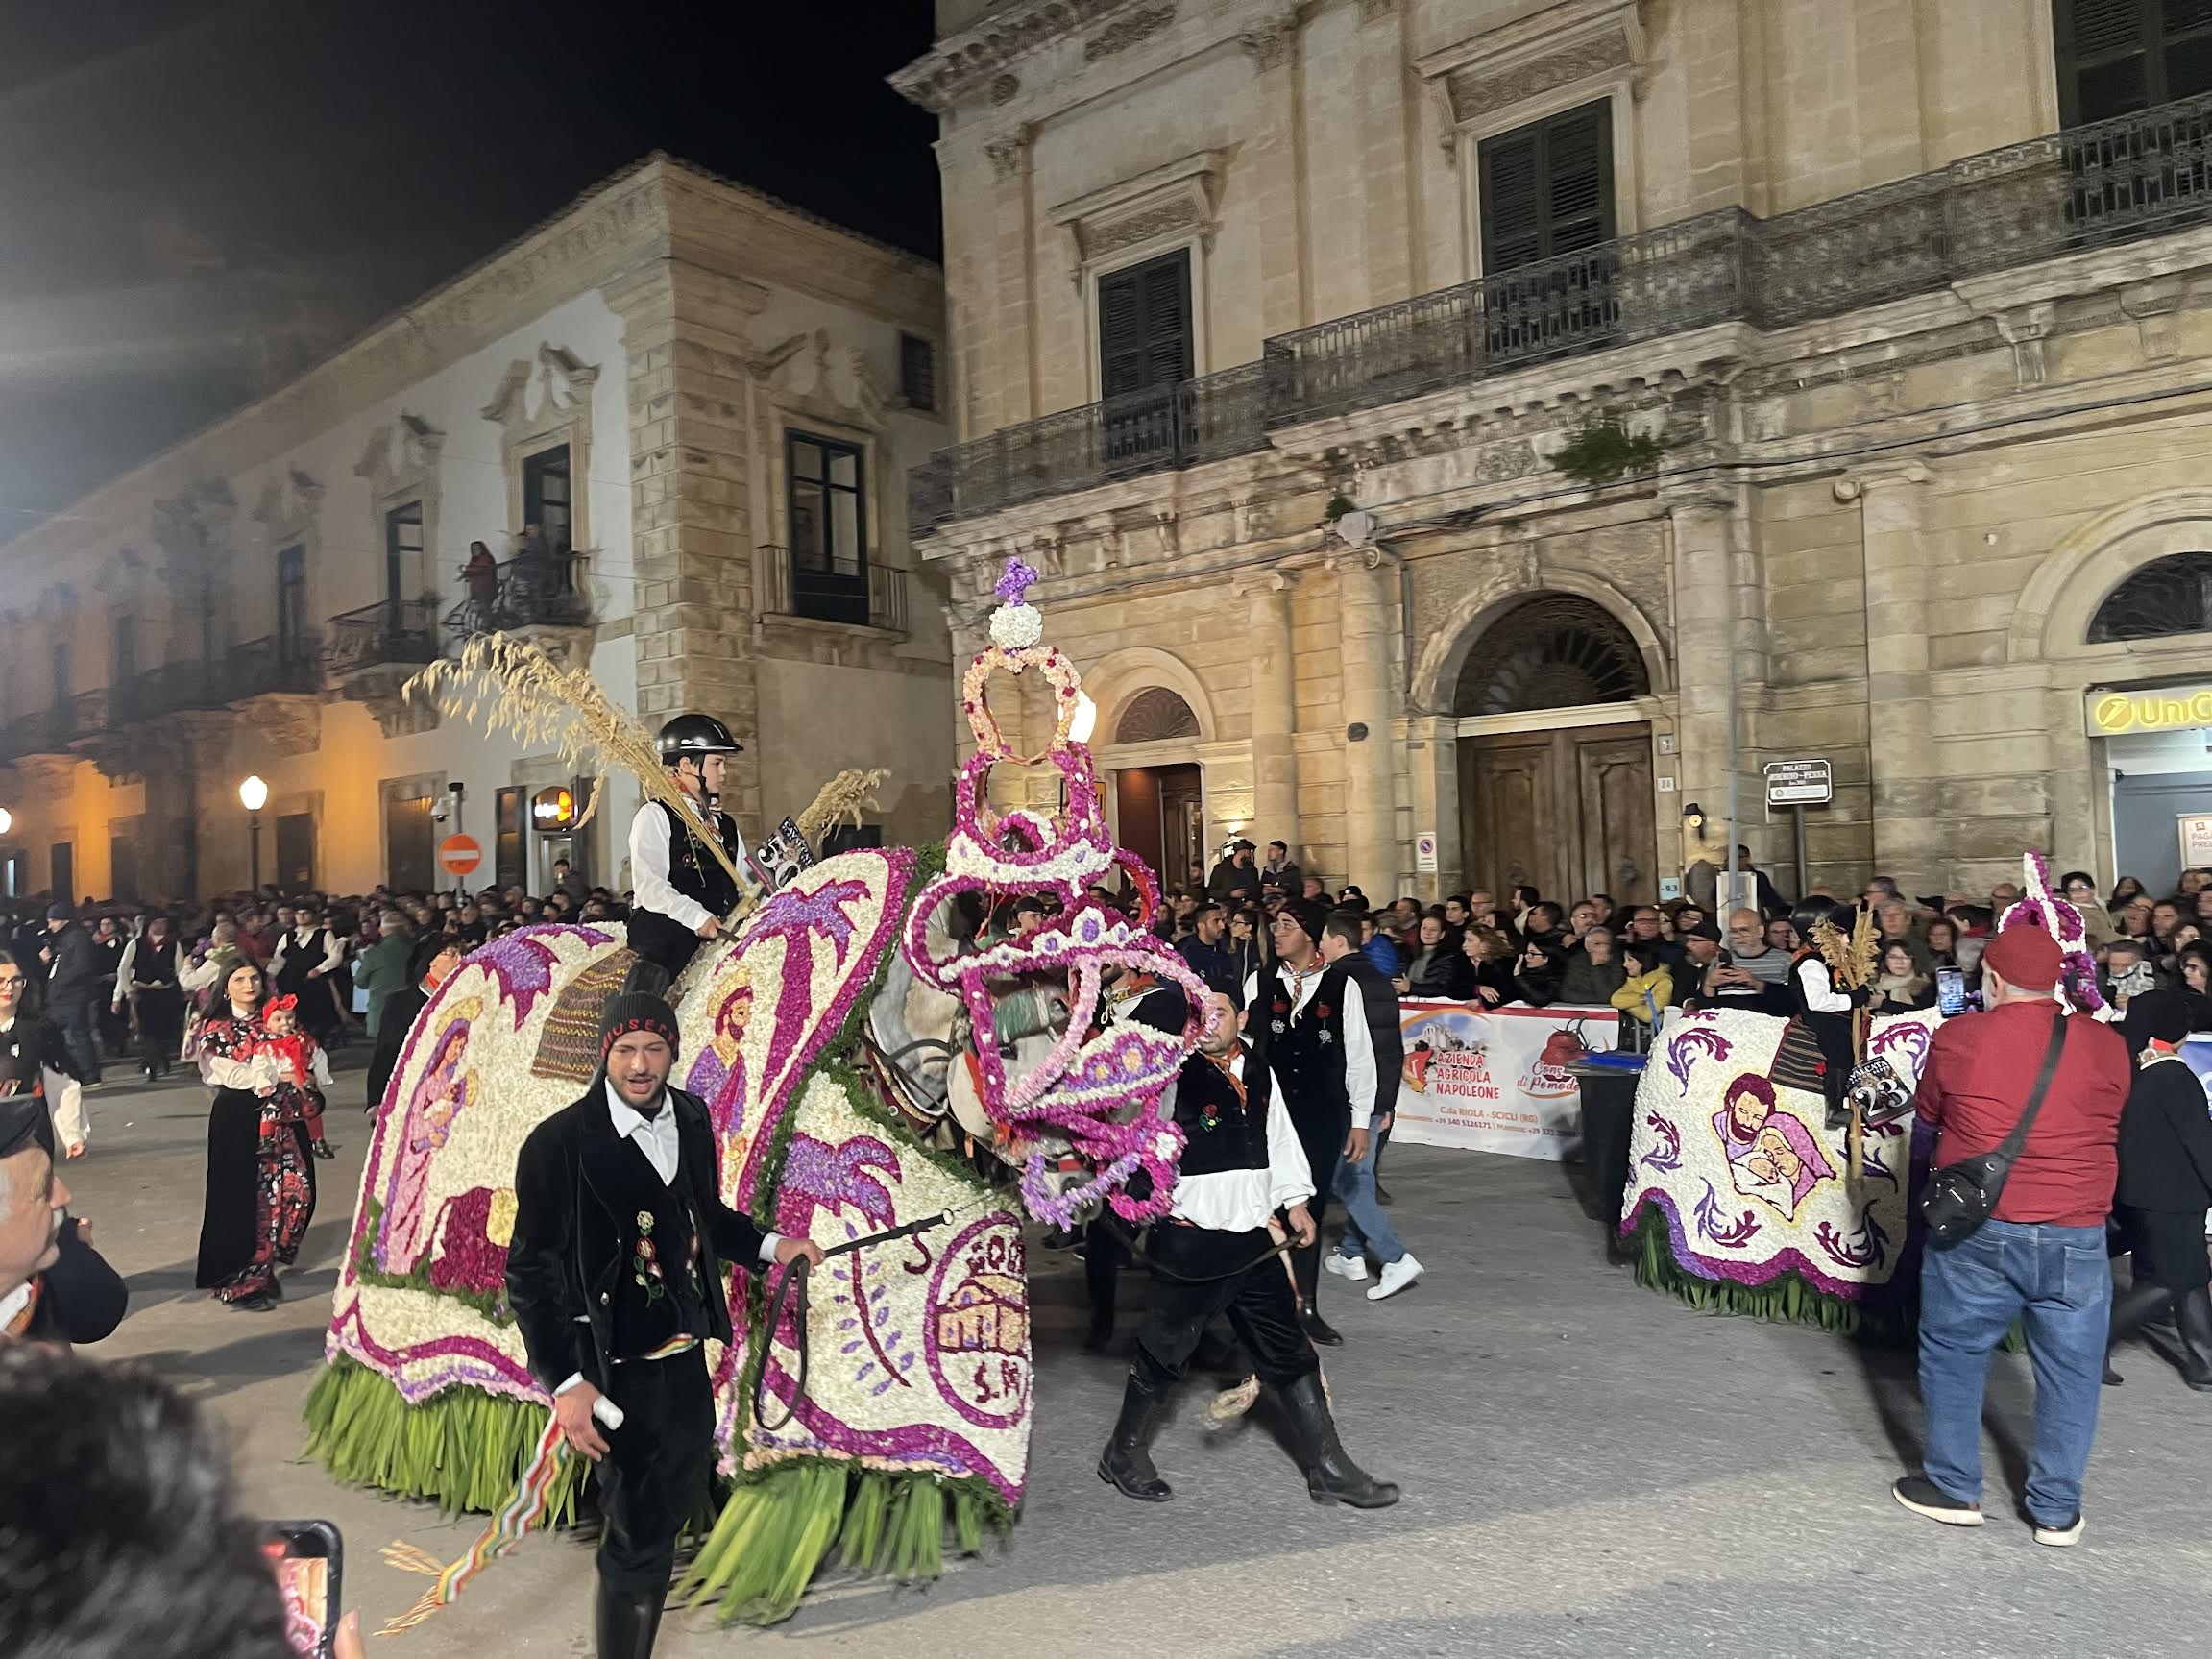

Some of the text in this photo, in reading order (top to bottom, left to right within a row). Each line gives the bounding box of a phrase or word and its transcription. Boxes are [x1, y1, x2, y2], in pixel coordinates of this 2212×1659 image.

[1437, 1052, 1484, 1066] AZIENDA
[1436, 1067, 1491, 1084] AGRICOLA
[1532, 1061, 1563, 1078] Cons
[1436, 1083, 1500, 1099] NAPOLEONE
[1517, 1075, 1580, 1091] di Pomodo
[1855, 1079, 1908, 1117] 23
[1459, 1108, 1485, 1118] RIOLA
